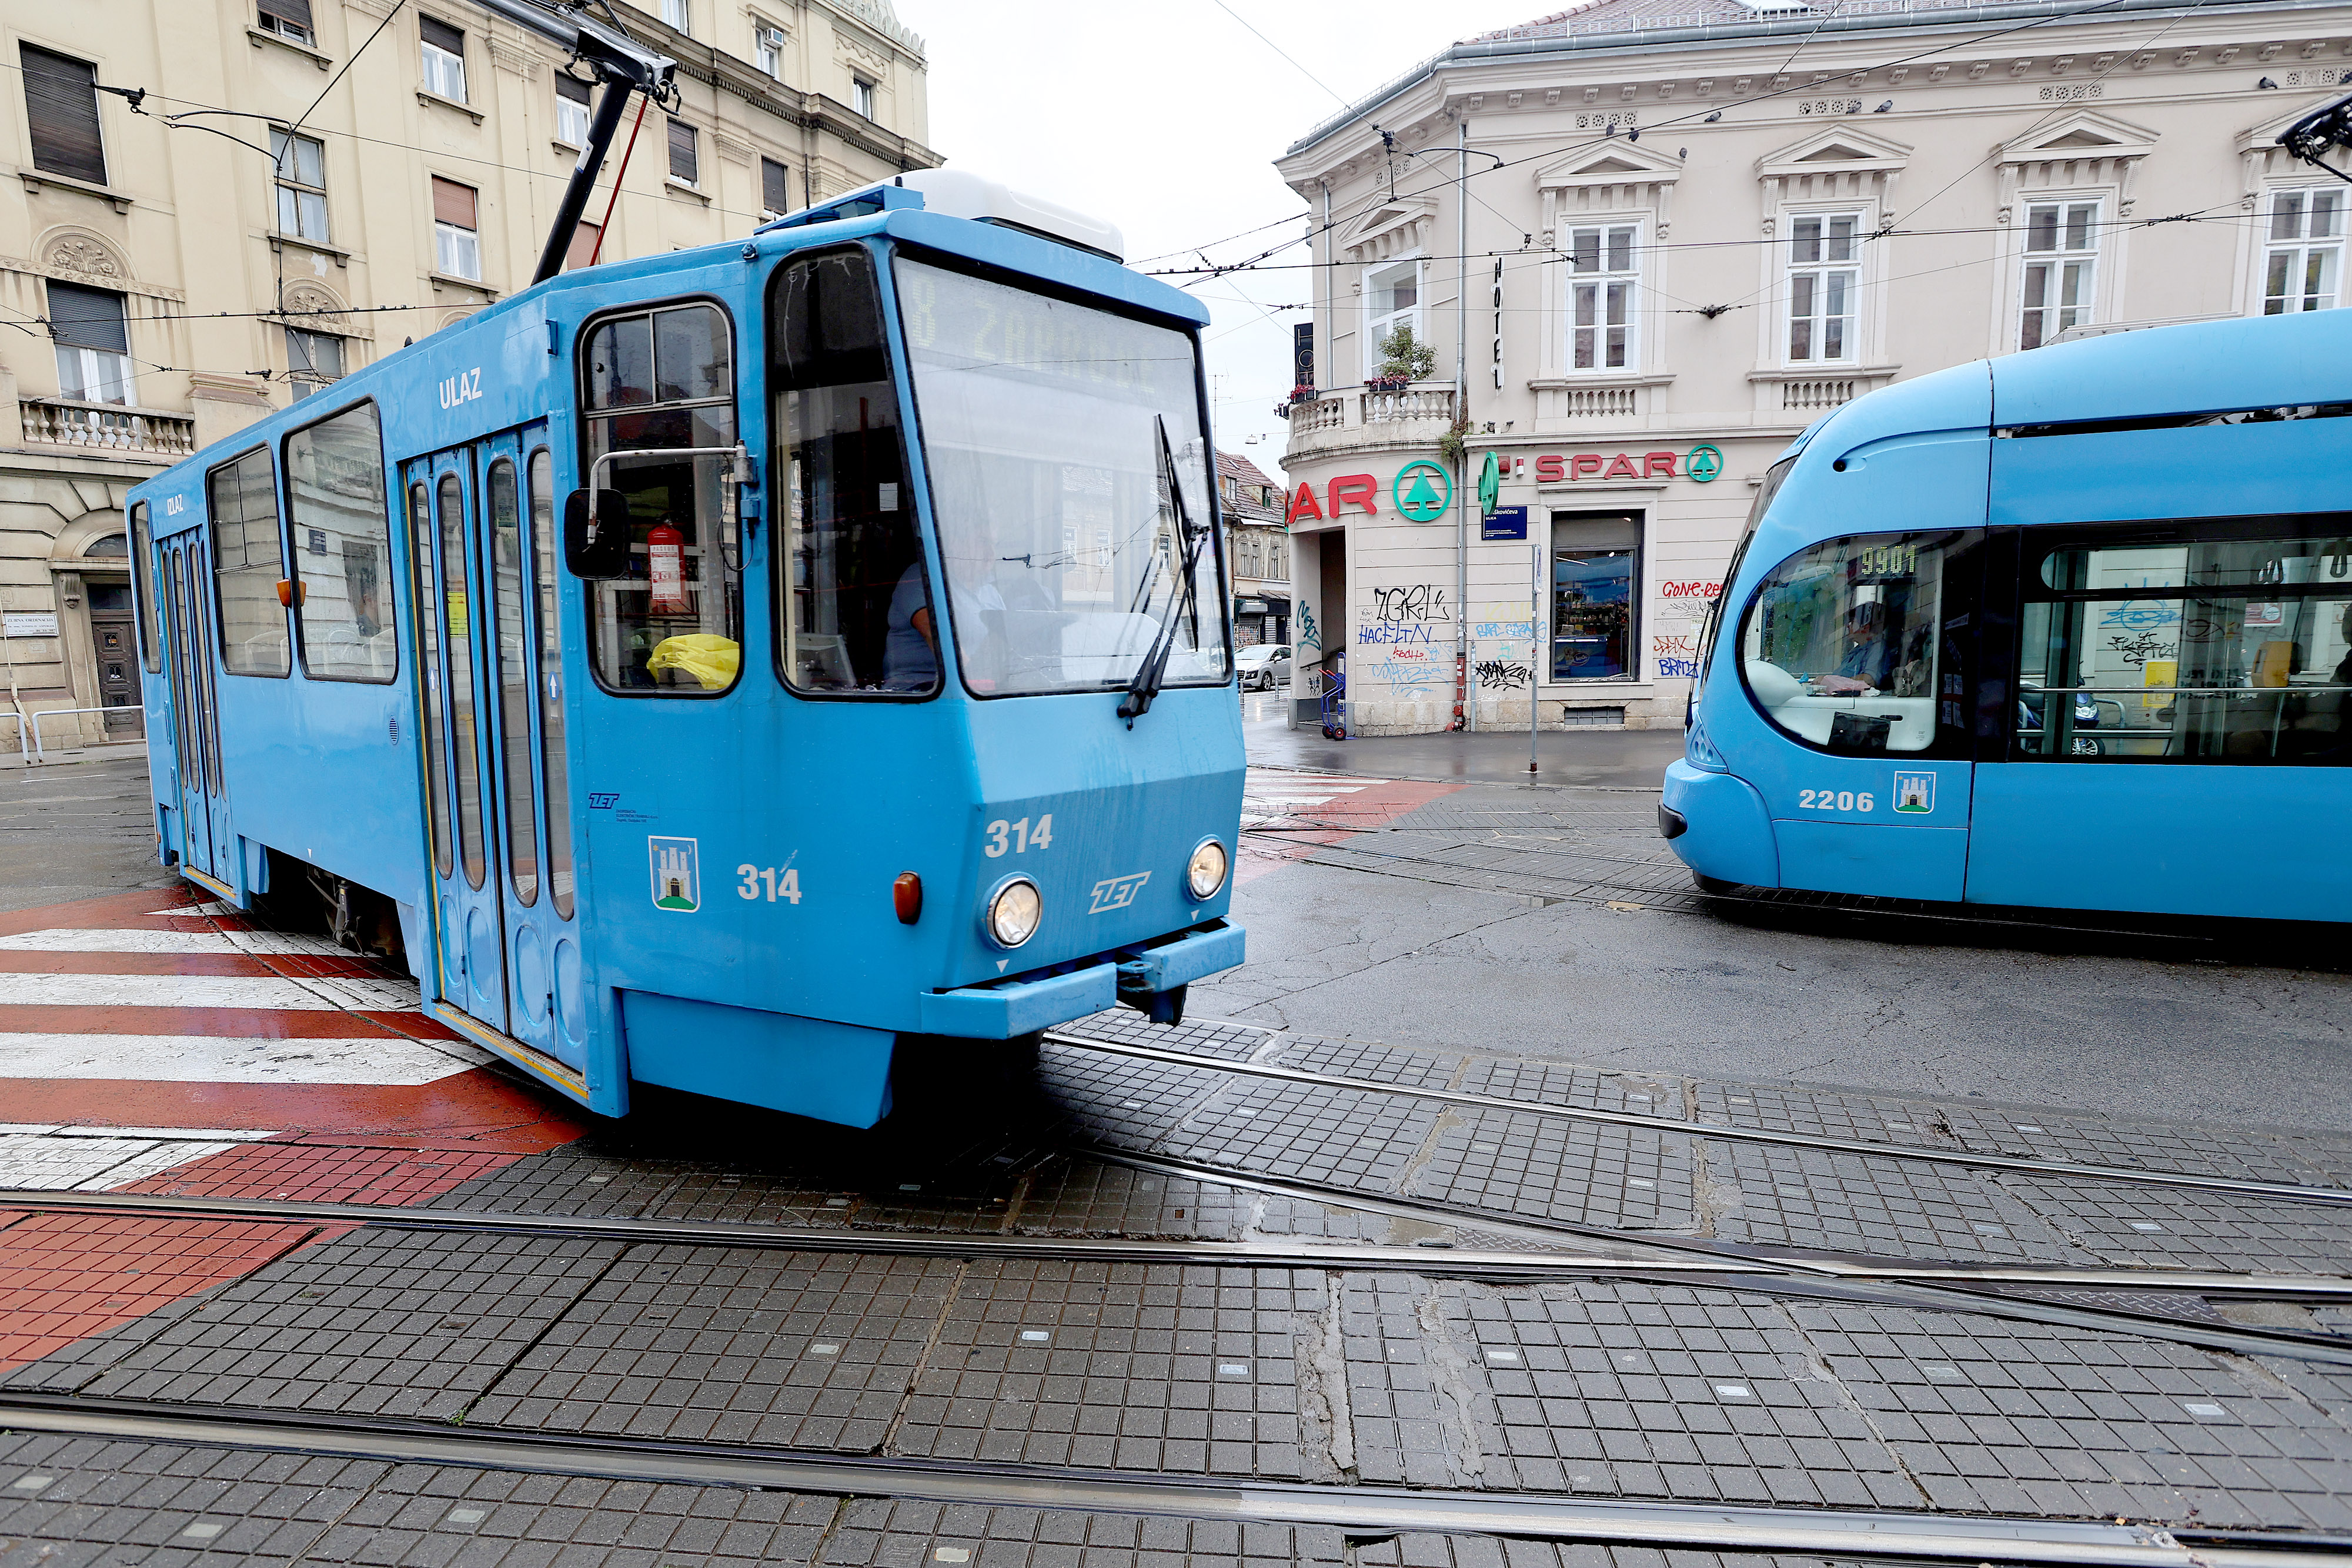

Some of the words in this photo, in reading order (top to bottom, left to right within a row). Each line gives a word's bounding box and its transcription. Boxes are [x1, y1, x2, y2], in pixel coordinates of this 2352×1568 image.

[439, 366, 482, 410] ULAZ
[1536, 451, 1677, 482] SPAR
[167, 493, 184, 516] IZLAZ
[1285, 473, 1377, 527] AR
[589, 793, 620, 810] ZET
[1799, 789, 1875, 812] 2206
[983, 814, 1053, 858] 314
[736, 864, 802, 905] 314
[1088, 871, 1152, 915] ZET
